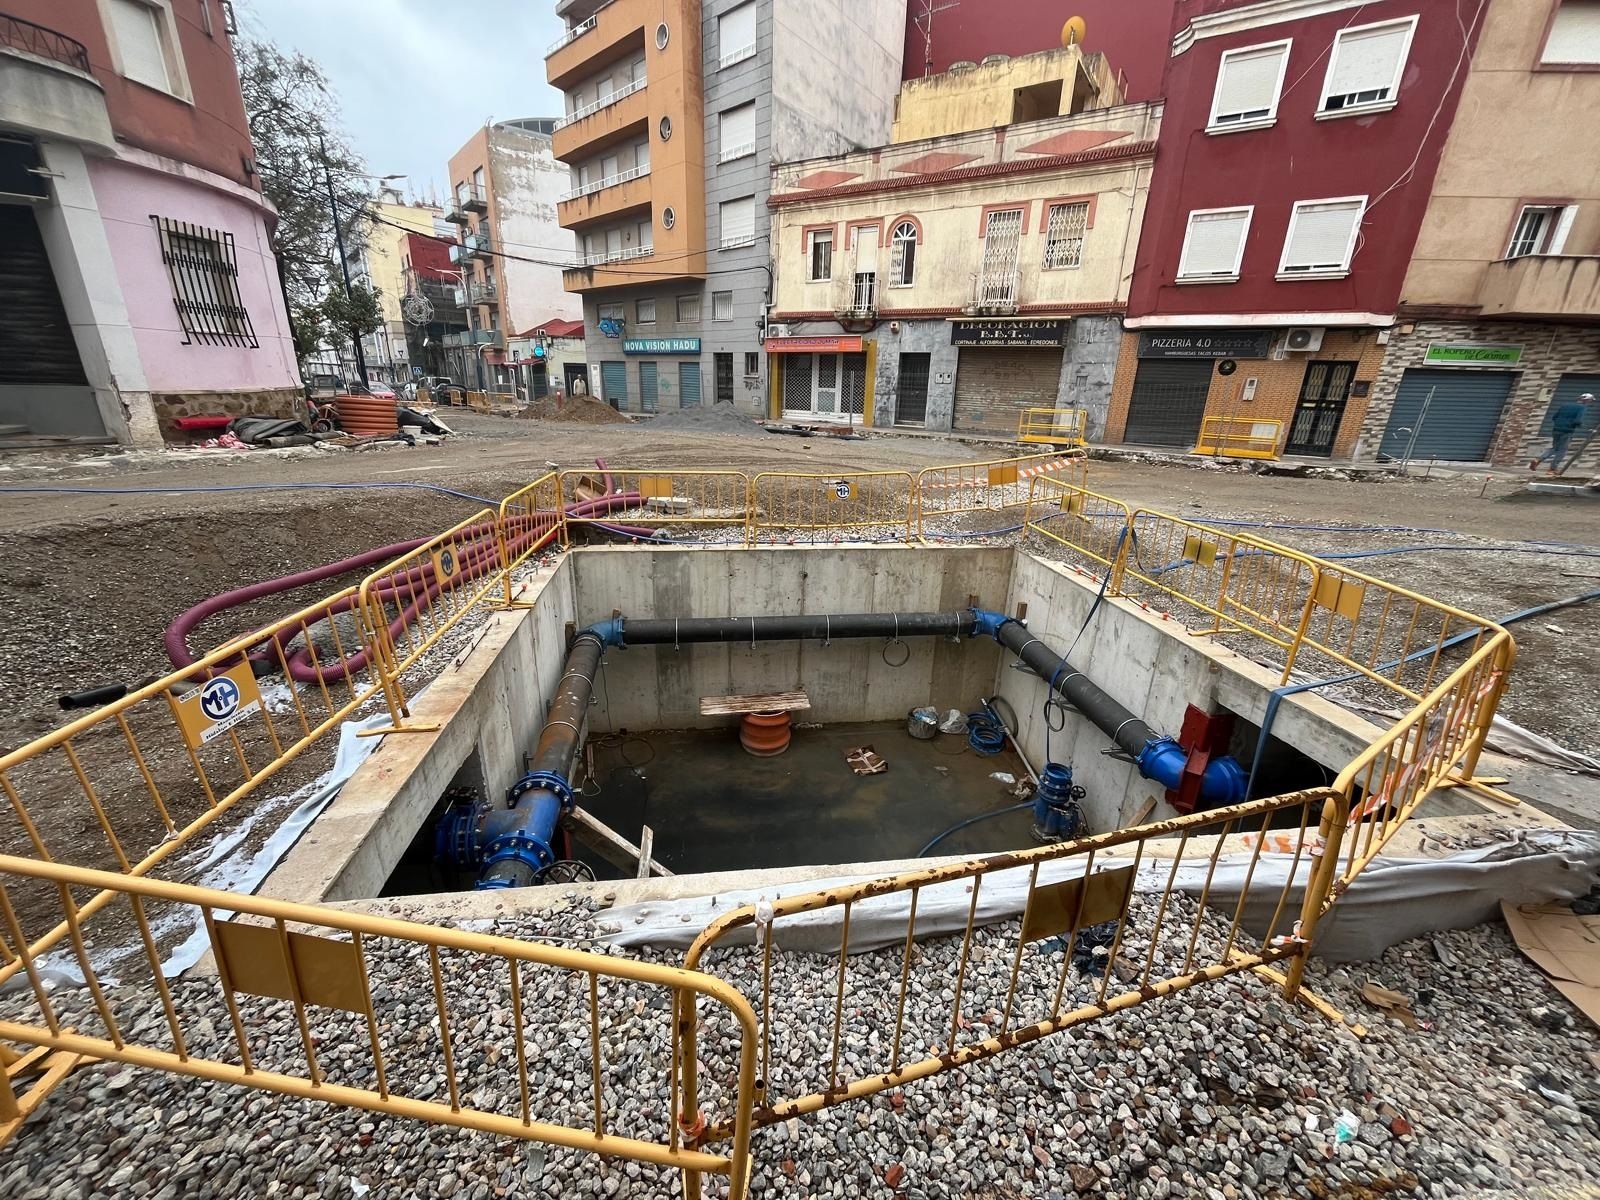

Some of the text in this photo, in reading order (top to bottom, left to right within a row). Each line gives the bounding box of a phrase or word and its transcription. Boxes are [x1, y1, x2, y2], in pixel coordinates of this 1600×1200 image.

[625, 341, 696, 350] NOVA VISION HADU
[1151, 338, 1211, 348] PIZZERIA 4.0
